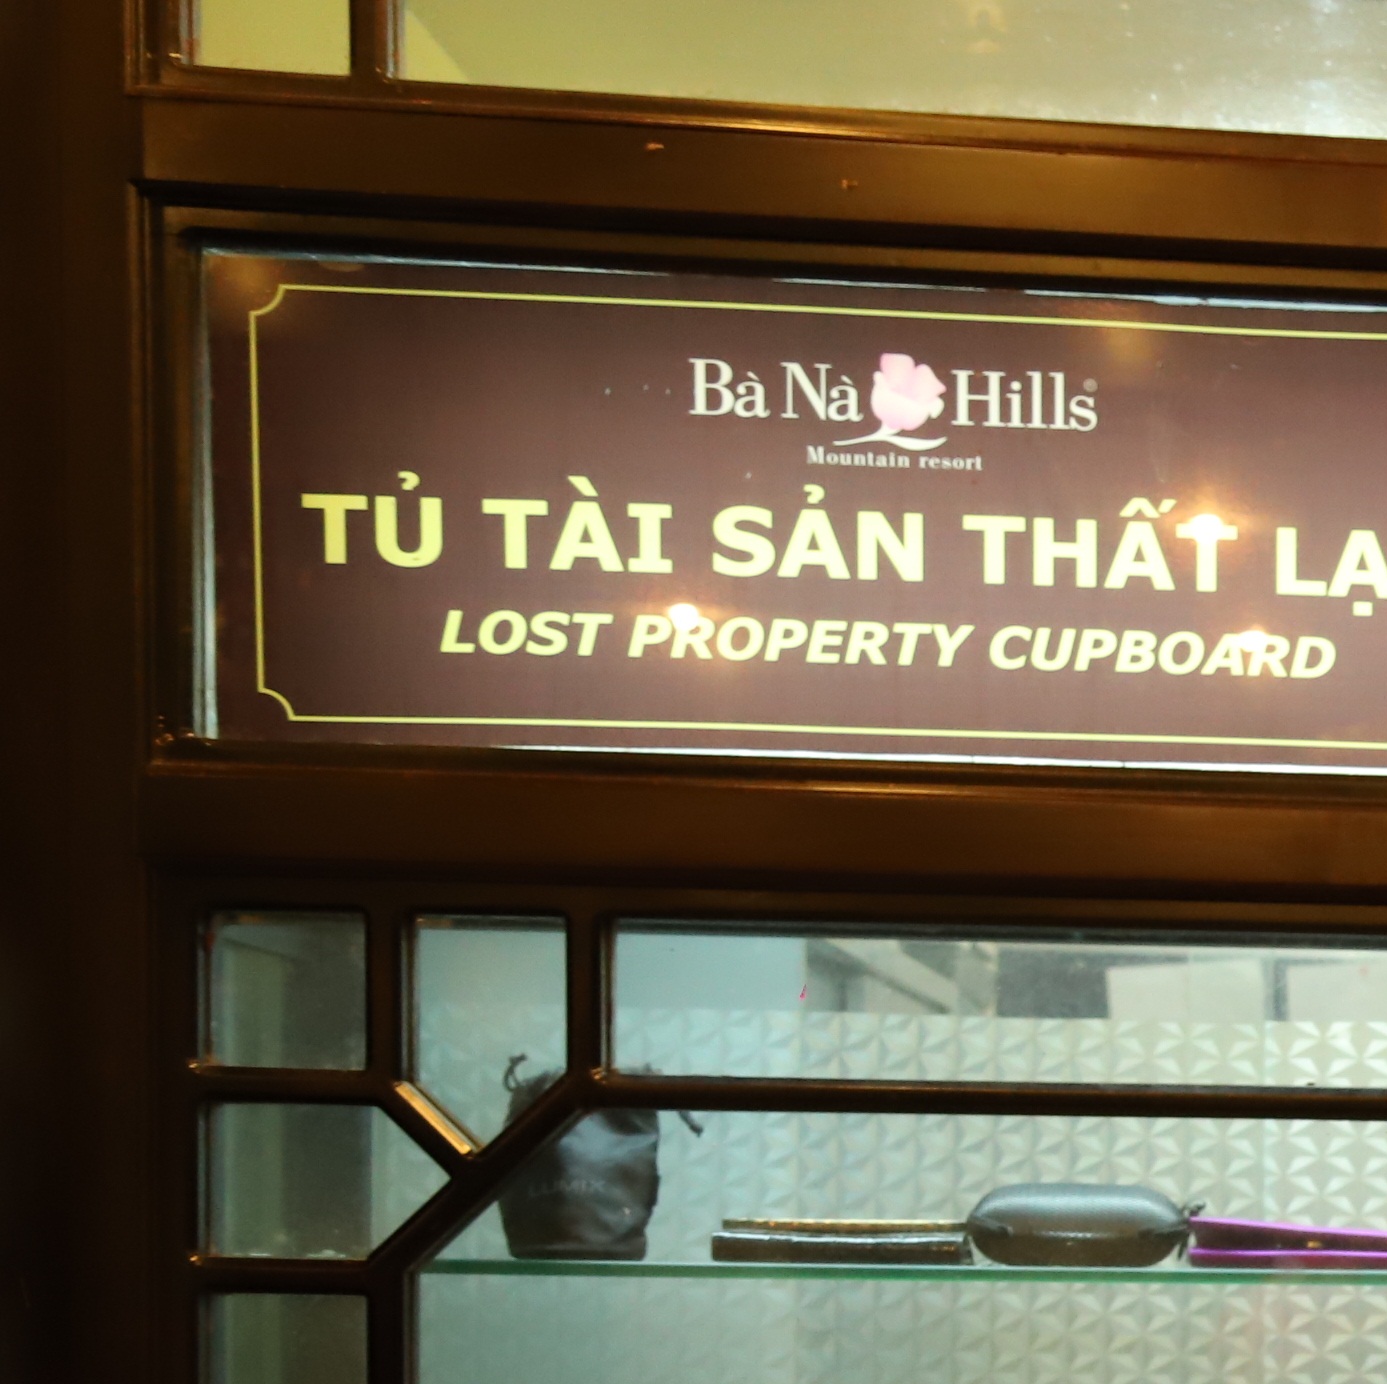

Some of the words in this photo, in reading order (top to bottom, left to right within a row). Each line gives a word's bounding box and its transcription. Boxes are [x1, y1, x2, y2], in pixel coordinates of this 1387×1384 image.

[689, 358, 770, 418] Bà
[780, 362, 864, 423] Nà
[951, 369, 1098, 432] Hills
[806, 445, 910, 468] Mountain
[919, 454, 983, 471] resort
[301, 470, 443, 568] TỦ
[482, 475, 673, 574] TÀI
[711, 484, 924, 580] SẢN
[962, 497, 1238, 593] THẤT
[440, 609, 613, 657] LOST
[628, 614, 975, 666] PROPERTY
[988, 625, 1336, 678] CUPBOARD
